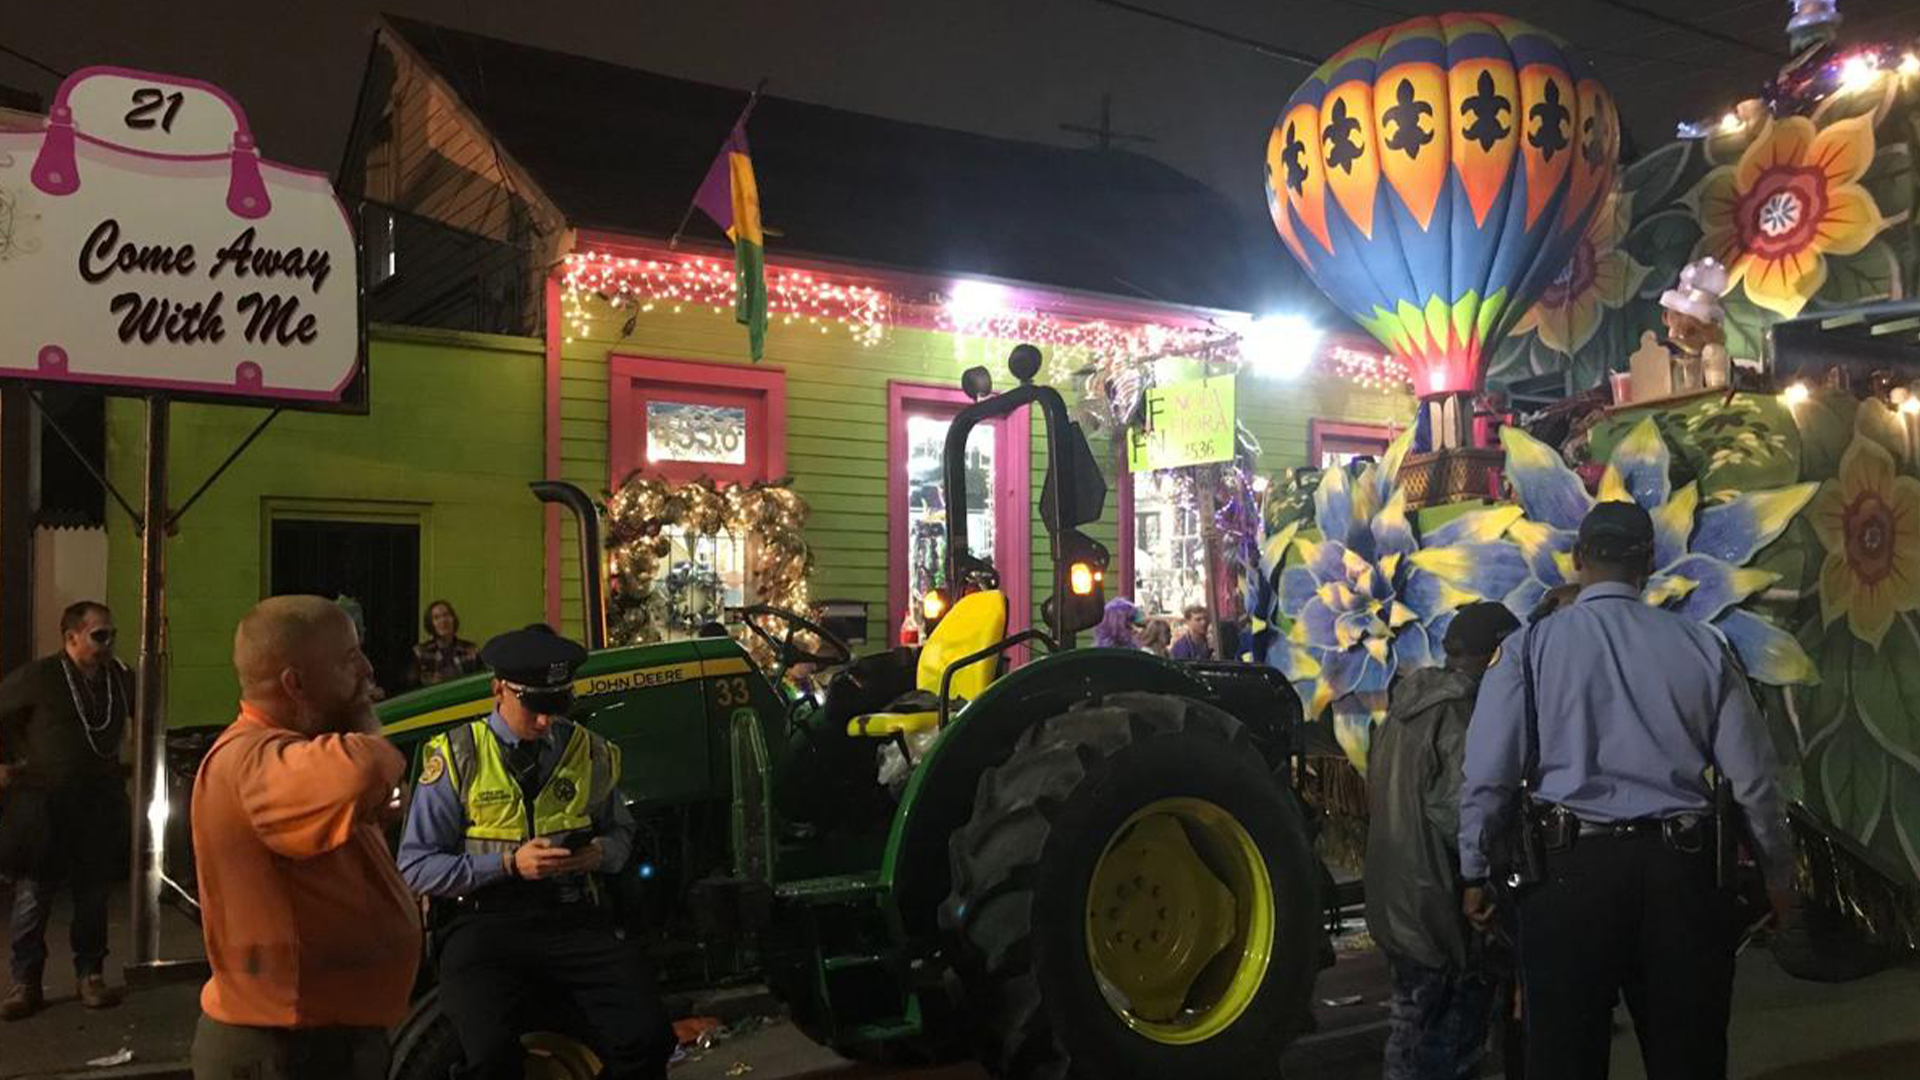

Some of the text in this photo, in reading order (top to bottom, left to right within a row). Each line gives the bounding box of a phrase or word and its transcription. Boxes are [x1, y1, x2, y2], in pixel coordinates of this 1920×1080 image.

[124, 88, 184, 134] 21
[79, 219, 332, 295] Come Away
[110, 291, 318, 347] With Me
[586, 669, 685, 694] JOHN DEERE
[716, 678, 749, 706] 33
